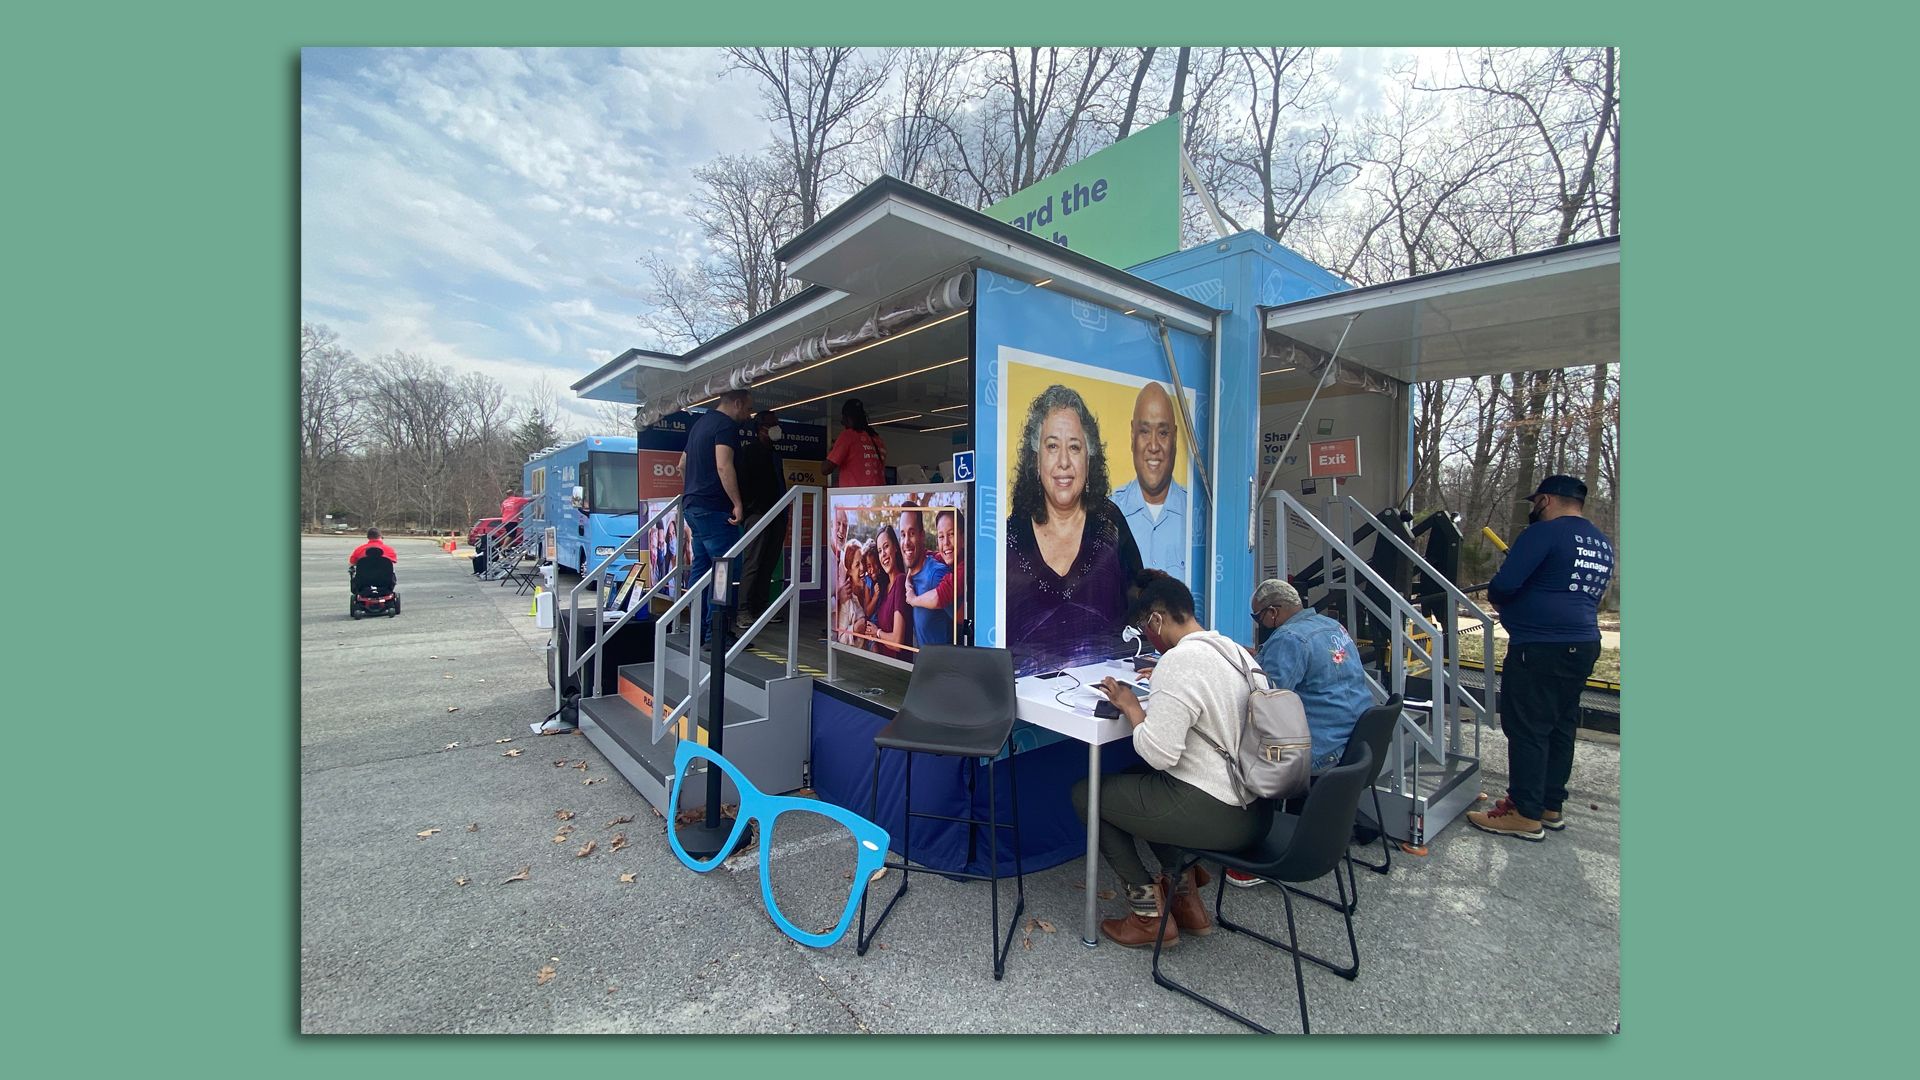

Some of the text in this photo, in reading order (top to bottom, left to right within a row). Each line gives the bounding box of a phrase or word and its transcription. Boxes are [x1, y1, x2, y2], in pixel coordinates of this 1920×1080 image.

[1008, 178, 1108, 232] ard the
[673, 421, 686, 430] Us
[786, 432, 820, 443] reasons
[1263, 455, 1297, 465] Stry
[1319, 453, 1346, 466] Exit
[788, 472, 815, 483] 40%
[1576, 546, 1597, 558] Tour
[1573, 558, 1609, 573] Manager
